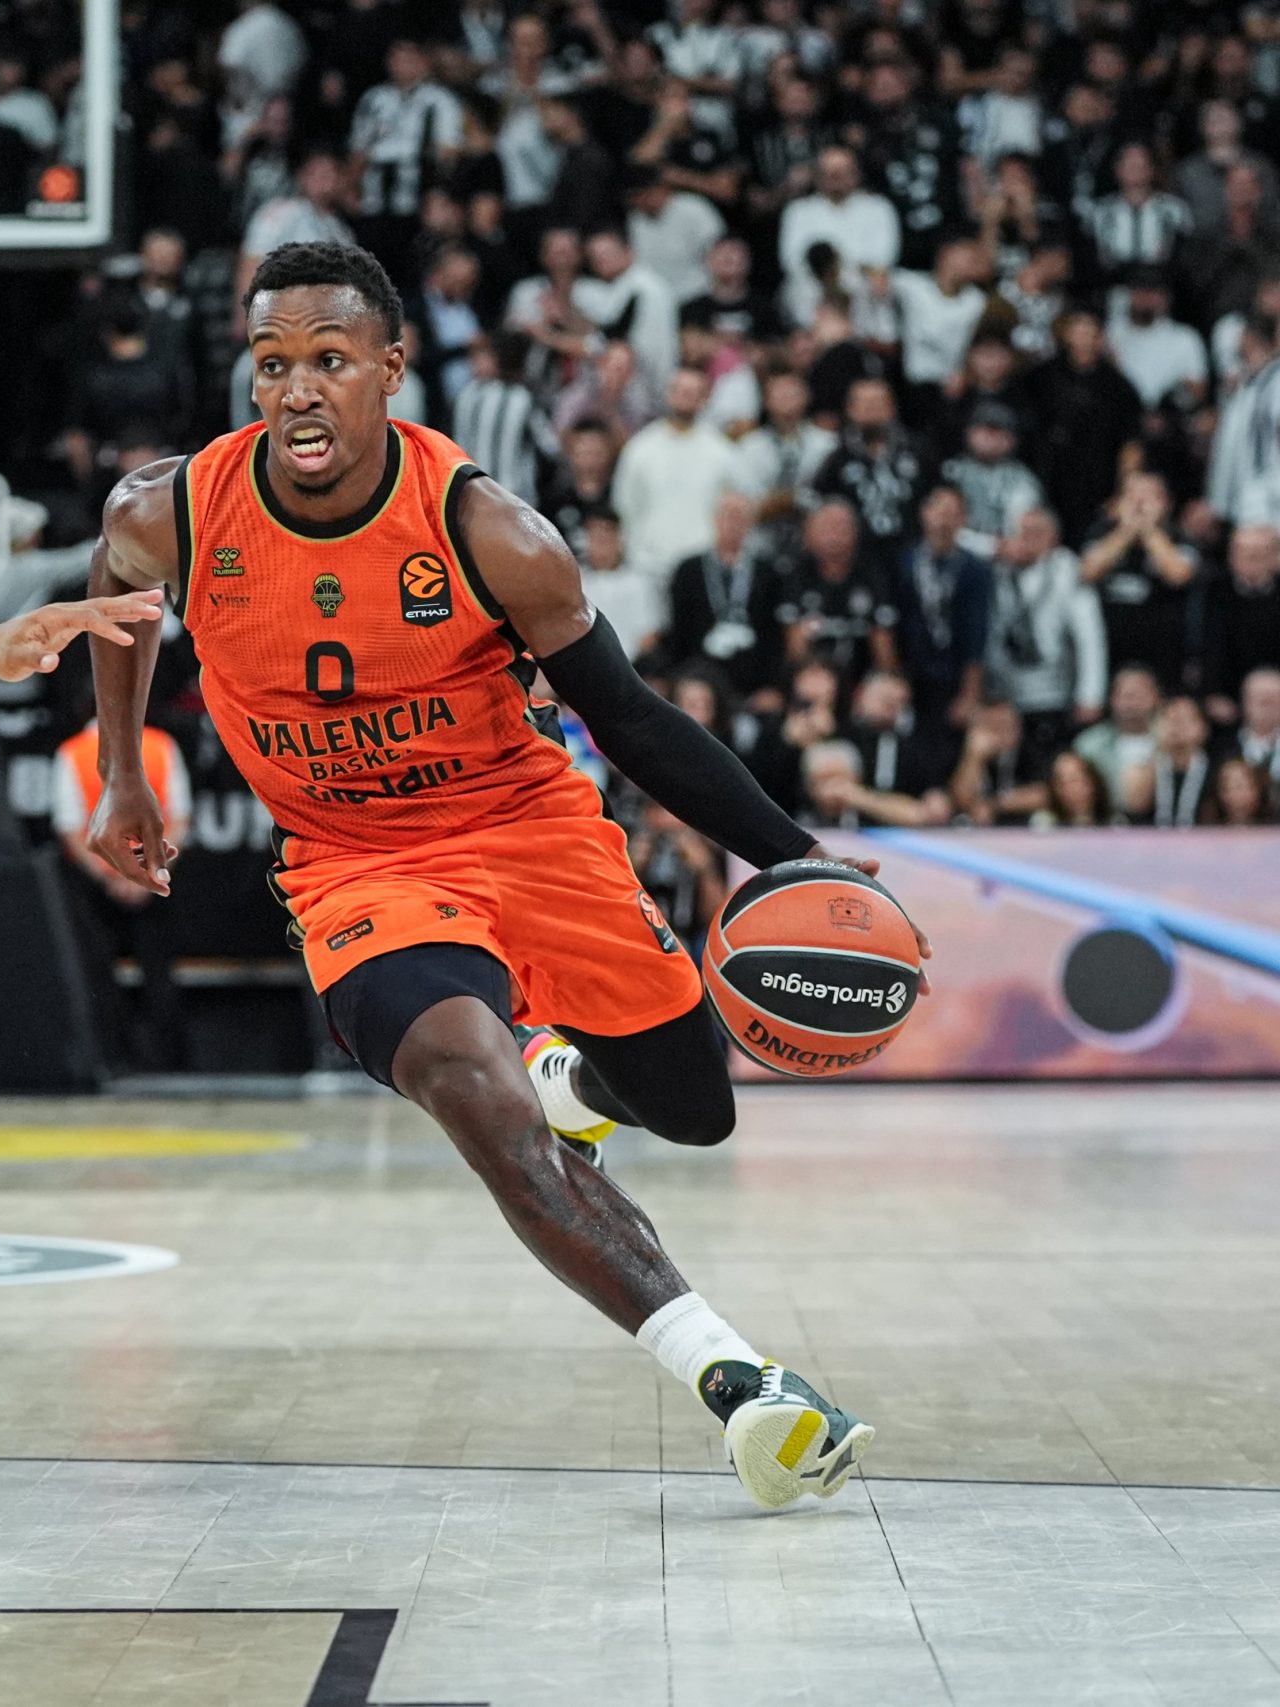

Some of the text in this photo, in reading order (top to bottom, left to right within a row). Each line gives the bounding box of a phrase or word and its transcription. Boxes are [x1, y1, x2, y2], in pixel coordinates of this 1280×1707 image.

[213, 566, 243, 576] hummel
[405, 608, 449, 618] ETIHAD
[306, 640, 355, 702] 0
[247, 696, 457, 758] VALENCIA
[308, 749, 412, 782] BASKE
[760, 971, 884, 1008] EuroLeague
